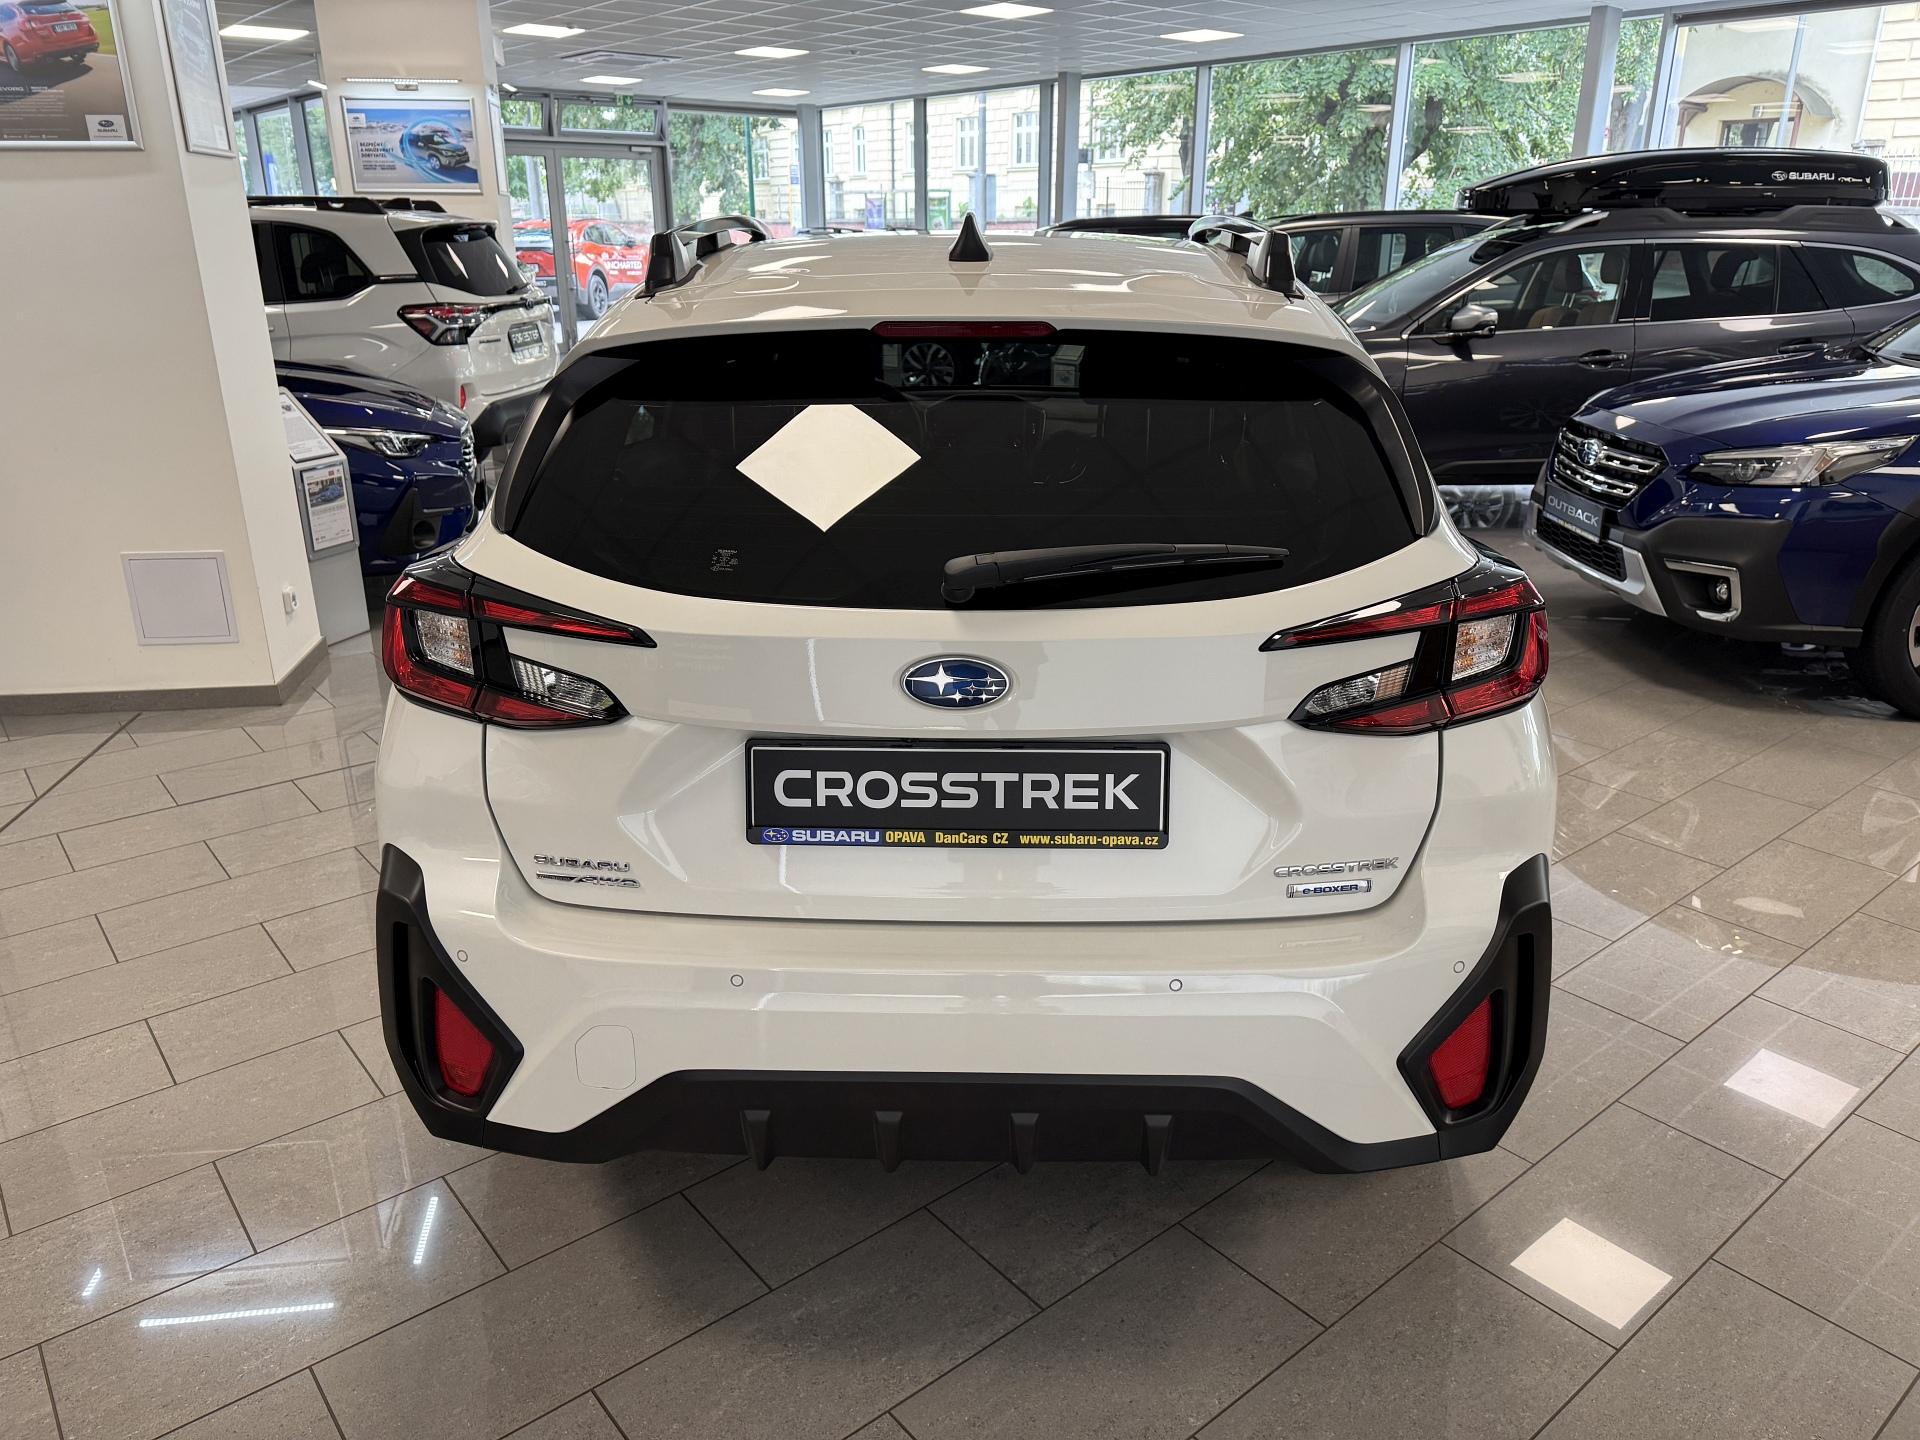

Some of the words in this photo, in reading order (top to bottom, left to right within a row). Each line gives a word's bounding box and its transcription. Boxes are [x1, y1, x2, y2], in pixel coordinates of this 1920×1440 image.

[1788, 172, 1835, 181] SUBARU
[1547, 495, 1600, 528] OUTBACK
[773, 769, 1141, 811] CROSSTREK
[791, 828, 880, 844] SUBARU
[885, 830, 926, 843] OPAVA
[934, 831, 988, 845] DanCars
[992, 832, 1009, 845] CZ
[1019, 833, 1160, 847] www.subaru-opava.cz
[533, 853, 631, 873] SUBARU
[1273, 856, 1399, 878] CROSSTREK
[1302, 883, 1360, 895] e-BOXER
